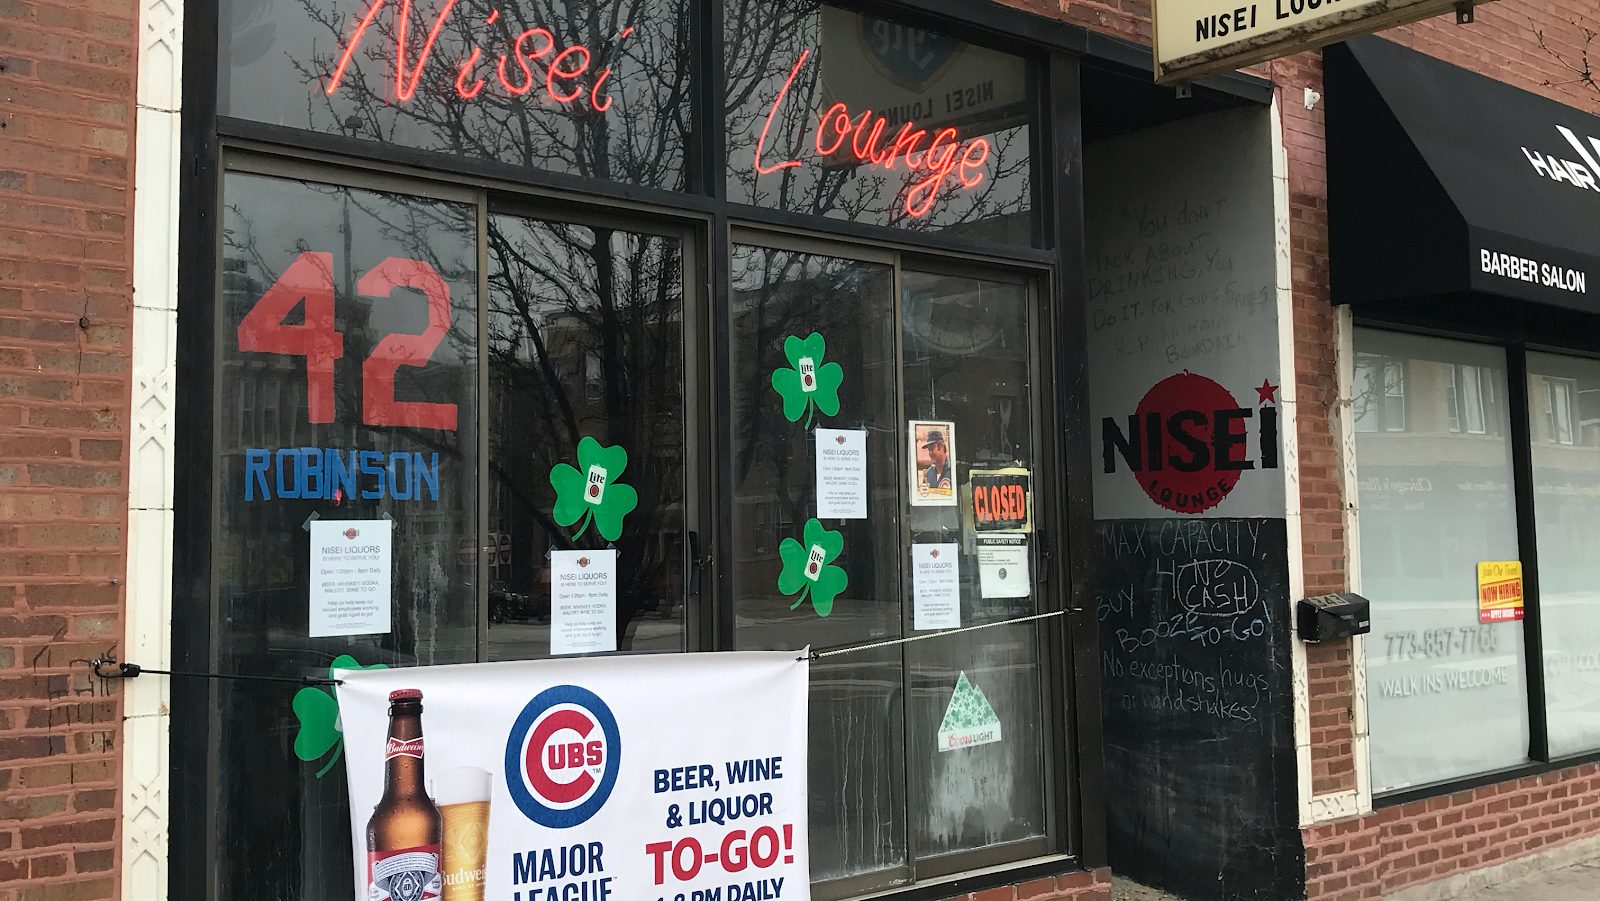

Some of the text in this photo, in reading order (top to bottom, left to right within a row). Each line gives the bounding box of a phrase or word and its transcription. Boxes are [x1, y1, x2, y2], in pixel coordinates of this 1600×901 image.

[1196, 4, 1257, 42] NISEI
[327, 0, 634, 112] Nisei
[754, 48, 990, 217] Lounge
[1520, 146, 1600, 193] HAIR
[1480, 248, 1586, 294] BARBER SALON
[237, 252, 458, 432] 42
[801, 364, 813, 375] Lite
[244, 447, 439, 502] ROBINSON
[589, 471, 605, 484] Lite
[1150, 478, 1232, 508] LOUNGE
[974, 484, 1025, 522] CLOSED
[321, 546, 381, 554] NISEI LIQUORS
[1101, 522, 1147, 559] MAX
[578, 572, 608, 580] LIQUORS
[1193, 559, 1232, 586] NO
[1097, 583, 1135, 622] BUY
[1186, 575, 1249, 614] CASH
[1482, 581, 1520, 604] NOW HIRING
[1116, 612, 1204, 653] BOOZE
[1103, 651, 1125, 678] No
[1380, 665, 1508, 699] WALK INS WELCOME
[973, 731, 994, 743] LIGHT
[653, 756, 784, 794] BEER, WINE
[666, 792, 773, 830] & LIQUOR
[513, 841, 605, 886] MAJOR
[645, 823, 795, 886] TO-GO!
[727, 877, 785, 901] DAILY
